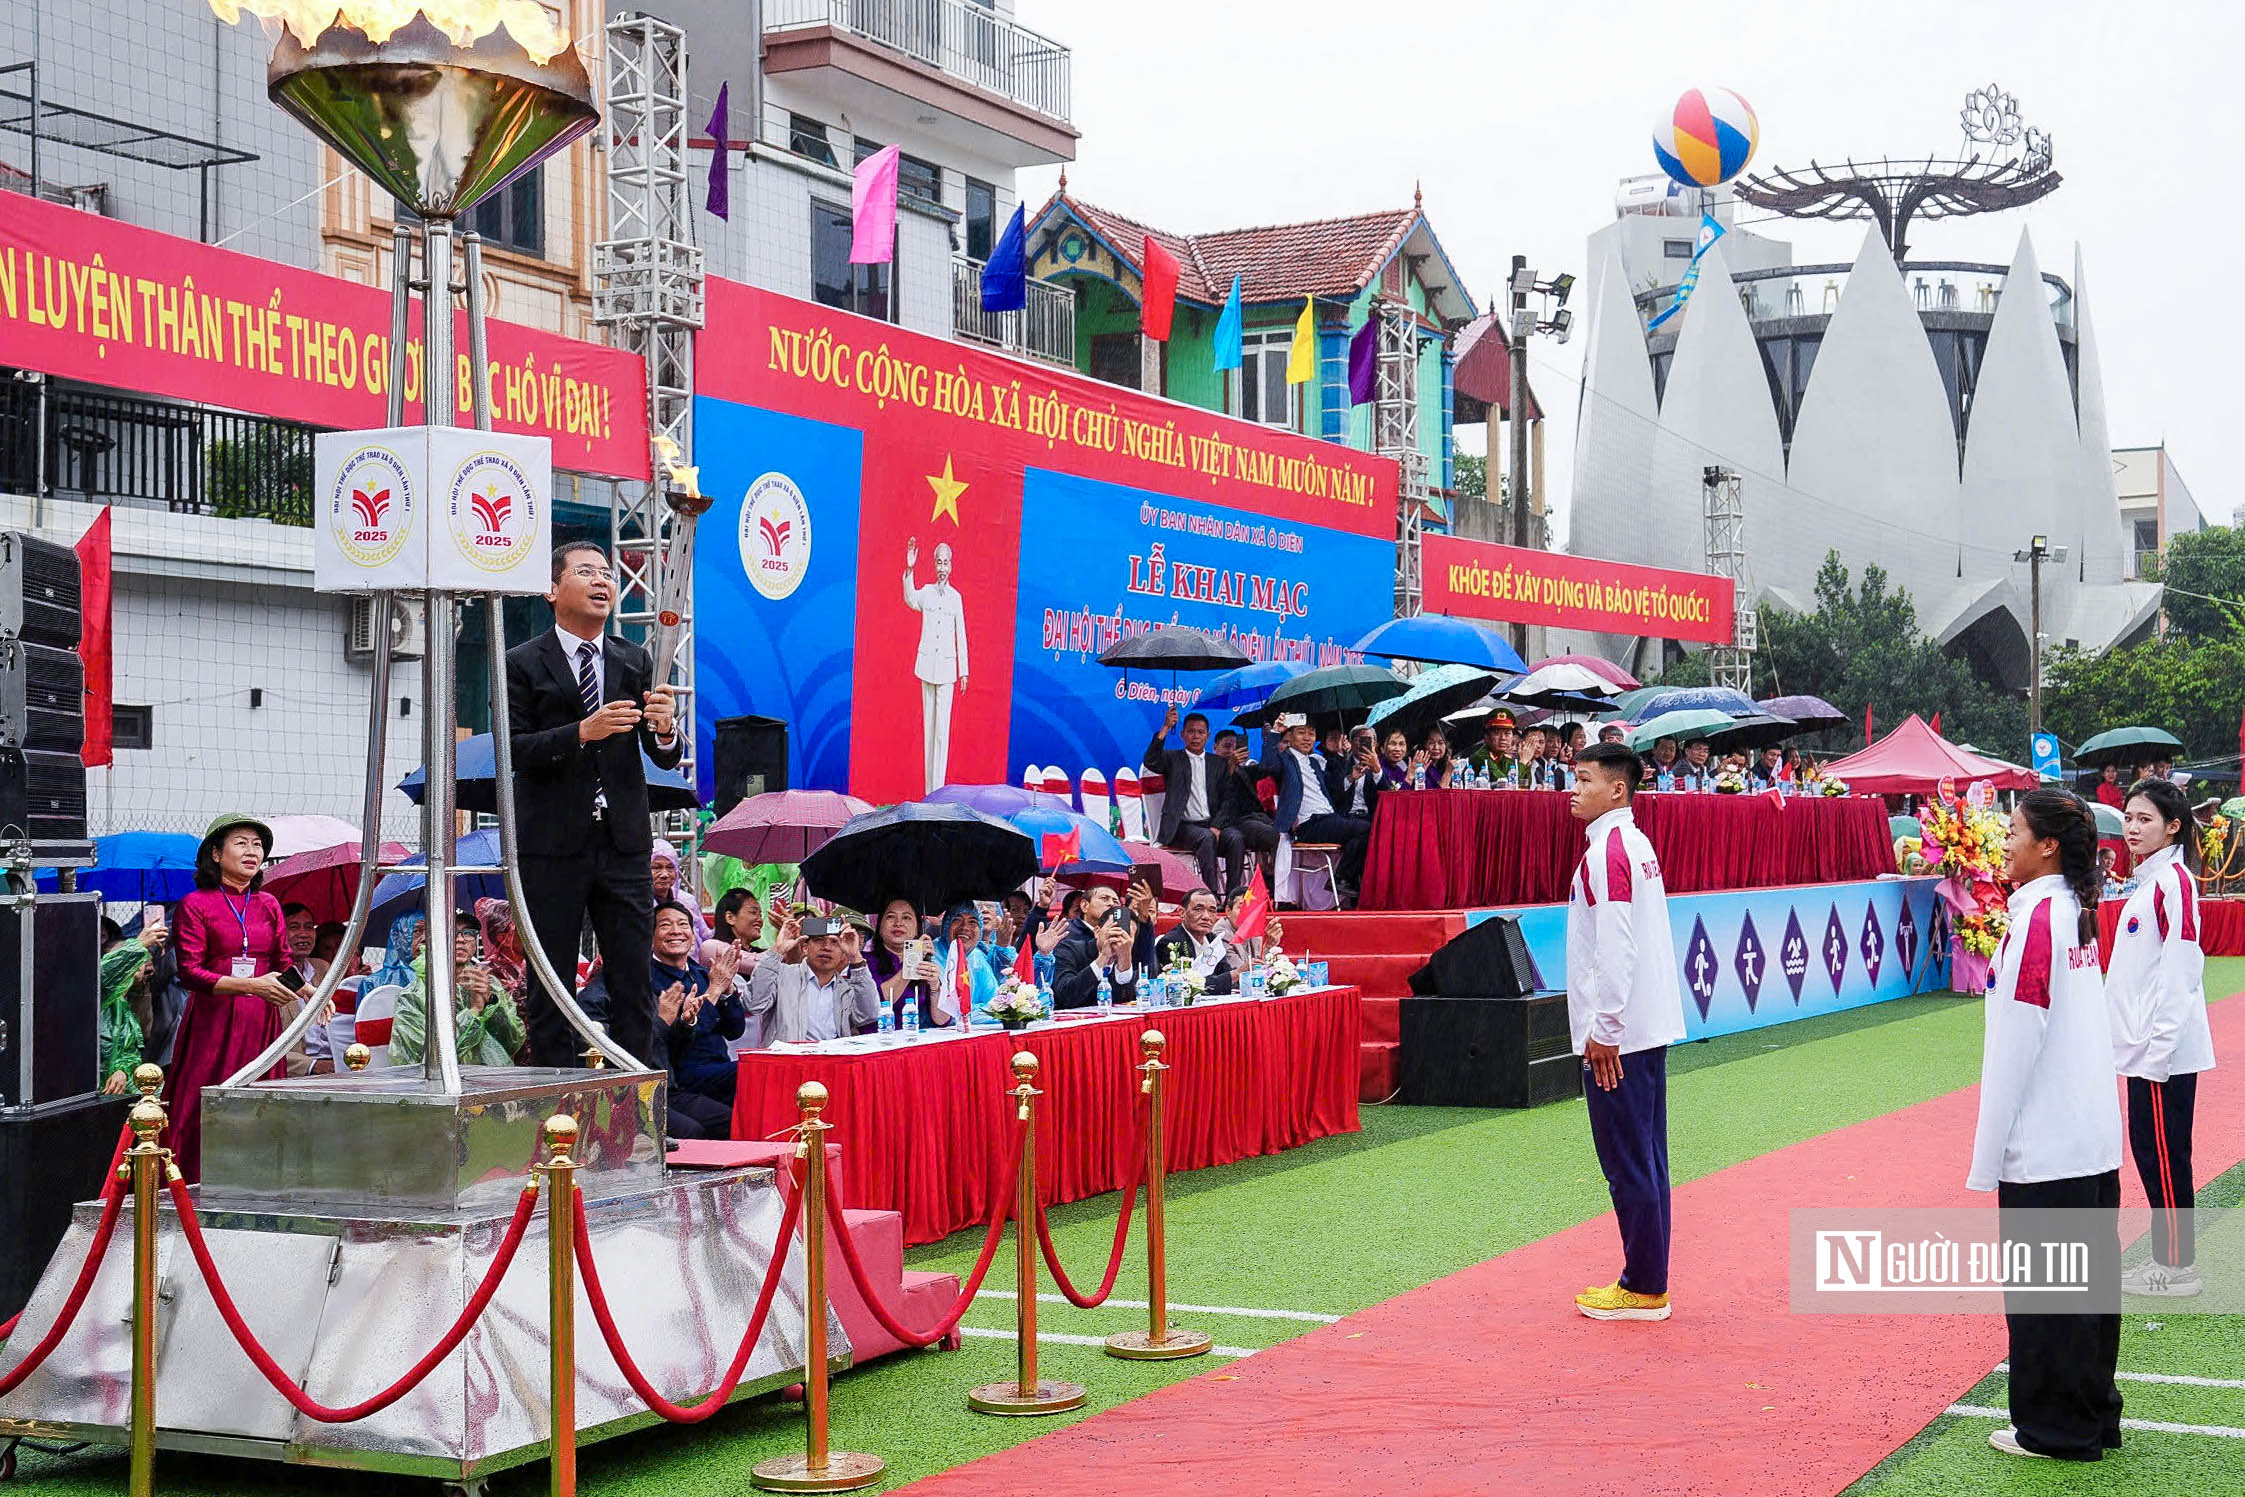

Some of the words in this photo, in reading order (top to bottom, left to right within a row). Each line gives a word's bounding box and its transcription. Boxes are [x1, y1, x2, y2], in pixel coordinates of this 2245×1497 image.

[26, 252, 133, 359] LUYỆN
[137, 275, 223, 363] THÂN
[227, 287, 283, 375] THỂ
[286, 314, 357, 390] THEO
[457, 353, 501, 419] BC
[505, 351, 539, 425] HỒ
[541, 363, 562, 430] VĨ
[768, 326, 850, 388] NƯỚC
[855, 343, 928, 410] CỘNG
[932, 364, 985, 422] HÒA
[989, 380, 1022, 430] XÃ
[1028, 390, 1068, 450] HỘI
[1072, 404, 1119, 453] CHỦ
[1121, 420, 1187, 469] NGHĨA
[1189, 431, 1233, 486] VIỆT
[1233, 447, 1274, 487] NAM
[1277, 454, 1328, 498] MUÔN
[1330, 464, 1366, 506] NĂM
[354, 531, 388, 541] 2025
[475, 535, 512, 547] 2025
[1140, 500, 1159, 526] ỦY
[1160, 509, 1186, 532] BAN
[1188, 515, 1224, 539] NHÂN
[1224, 521, 1249, 543] DÂN
[1251, 525, 1267, 547] XÃ
[1278, 531, 1304, 553] DIÊN
[762, 559, 788, 572] 2025
[1128, 542, 1165, 596] LỄ
[1171, 562, 1245, 609] KHAI
[1250, 575, 1309, 624] MẠC
[1449, 559, 1489, 597] KHỎE
[1492, 563, 1511, 600] ĐỂ
[1514, 570, 1542, 604] XÂY
[1543, 578, 1584, 613] DỰNG
[1584, 579, 1604, 611] VÀ
[1605, 580, 1632, 615] BẢO
[1633, 586, 1650, 624] VỆ
[1651, 584, 1668, 618] TỔ
[1043, 608, 1068, 662] ĐẠI
[1070, 604, 1095, 664] HỘI
